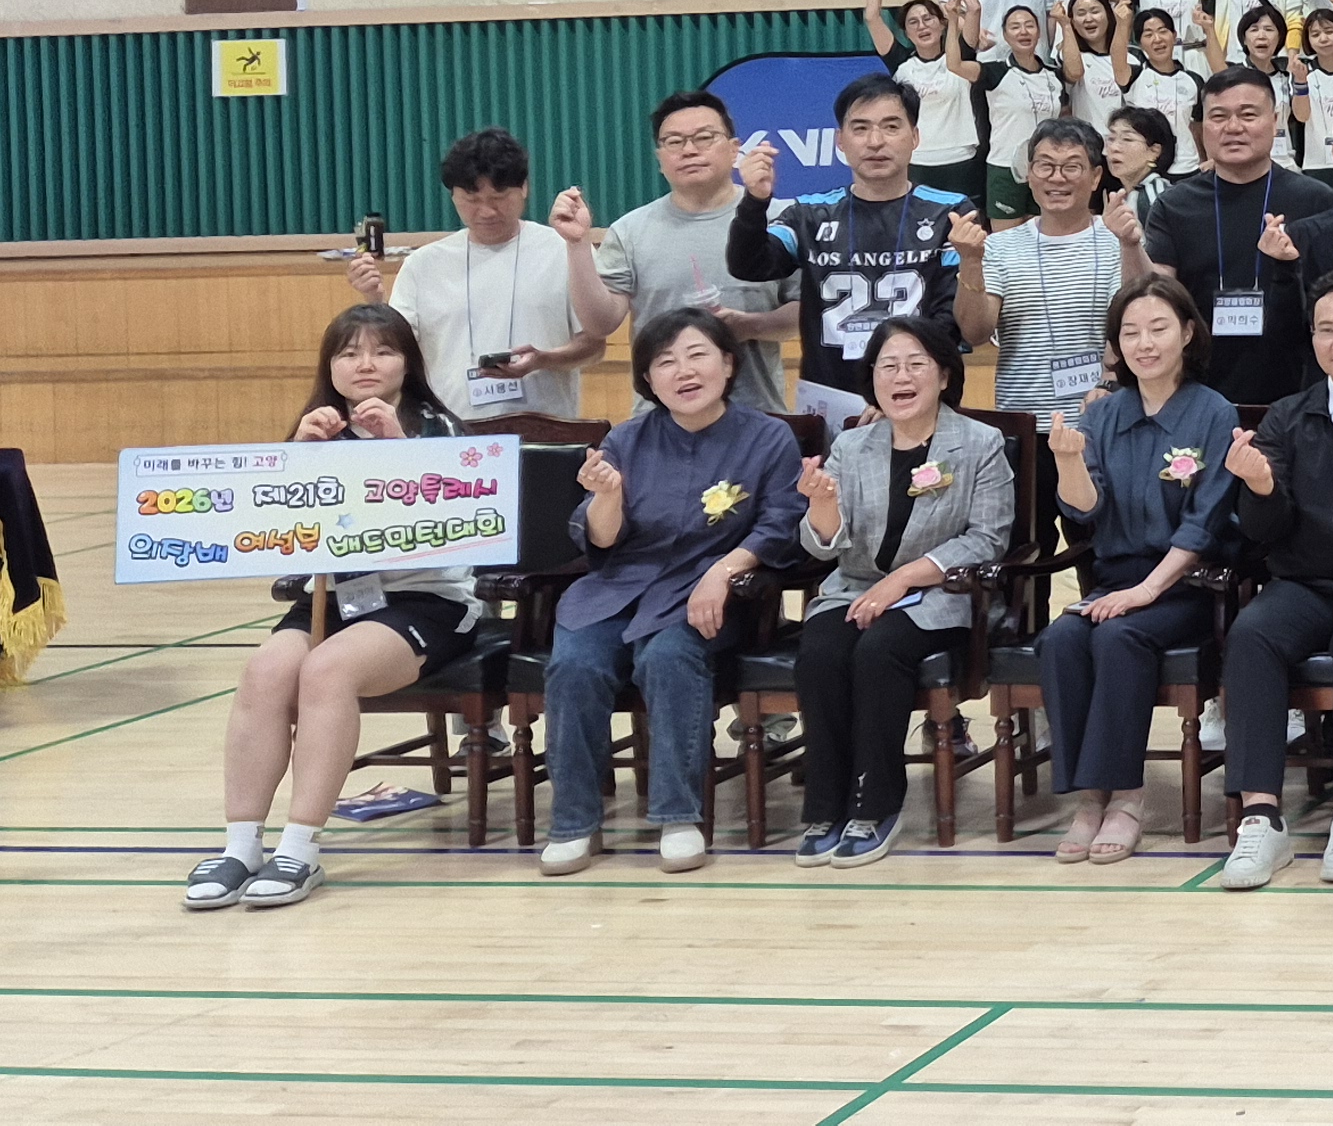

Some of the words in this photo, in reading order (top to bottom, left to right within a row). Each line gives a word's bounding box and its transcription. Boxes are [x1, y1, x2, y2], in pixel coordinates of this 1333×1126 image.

[777, 128, 849, 167] VI
[848, 245, 942, 267] ANGELE
[142, 457, 183, 473] 미래를
[187, 456, 226, 472] 바꾸는
[231, 456, 249, 472] 힘!
[252, 453, 279, 470] 고양
[135, 487, 235, 517] 2026년
[251, 476, 346, 508] 제21회
[363, 472, 499, 506] 고양특례시
[128, 533, 229, 568] 의장배
[233, 521, 321, 556] 여성부
[326, 507, 506, 558] 배드민턴대회
